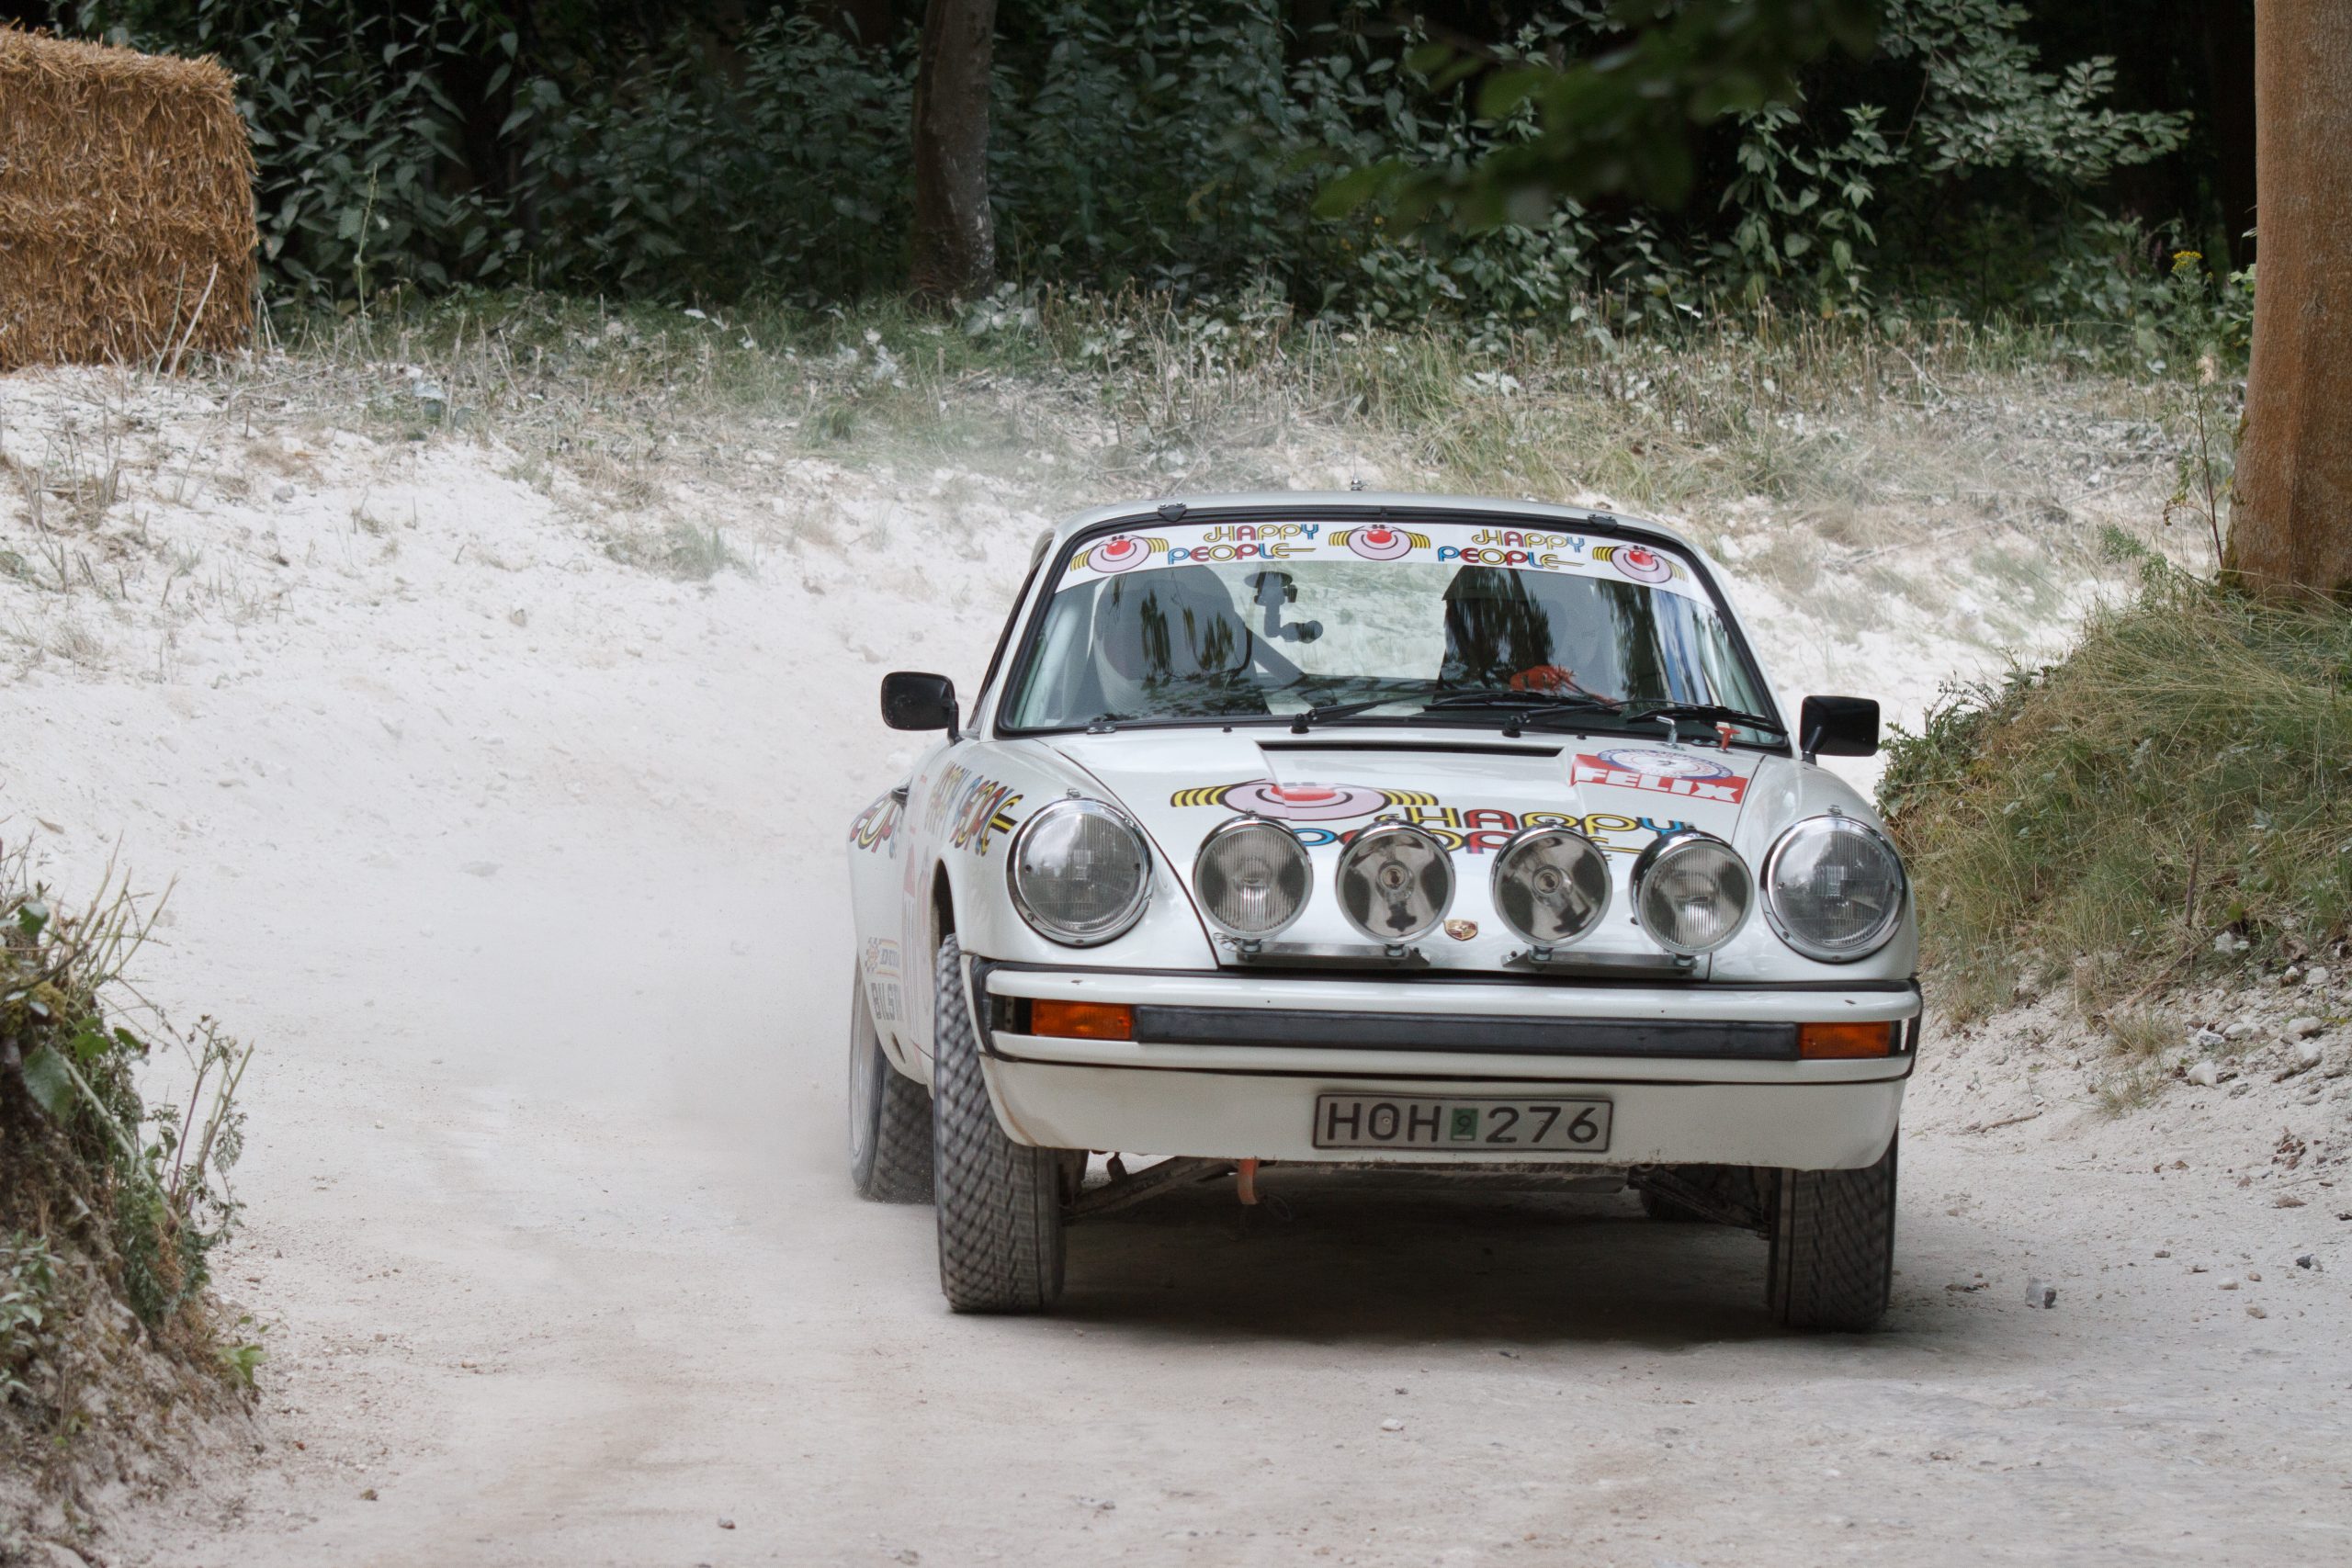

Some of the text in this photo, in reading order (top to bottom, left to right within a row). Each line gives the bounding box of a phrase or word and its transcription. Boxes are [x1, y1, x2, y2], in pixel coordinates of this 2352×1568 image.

[1204, 524, 1319, 543] HAPPY
[1472, 528, 1585, 553] HAPPY
[1168, 543, 1316, 565] PEOPLE
[1438, 546, 1585, 570] PEOPLE
[1574, 766, 1739, 803] FELIX
[1327, 1102, 1599, 1144] HOH 276
